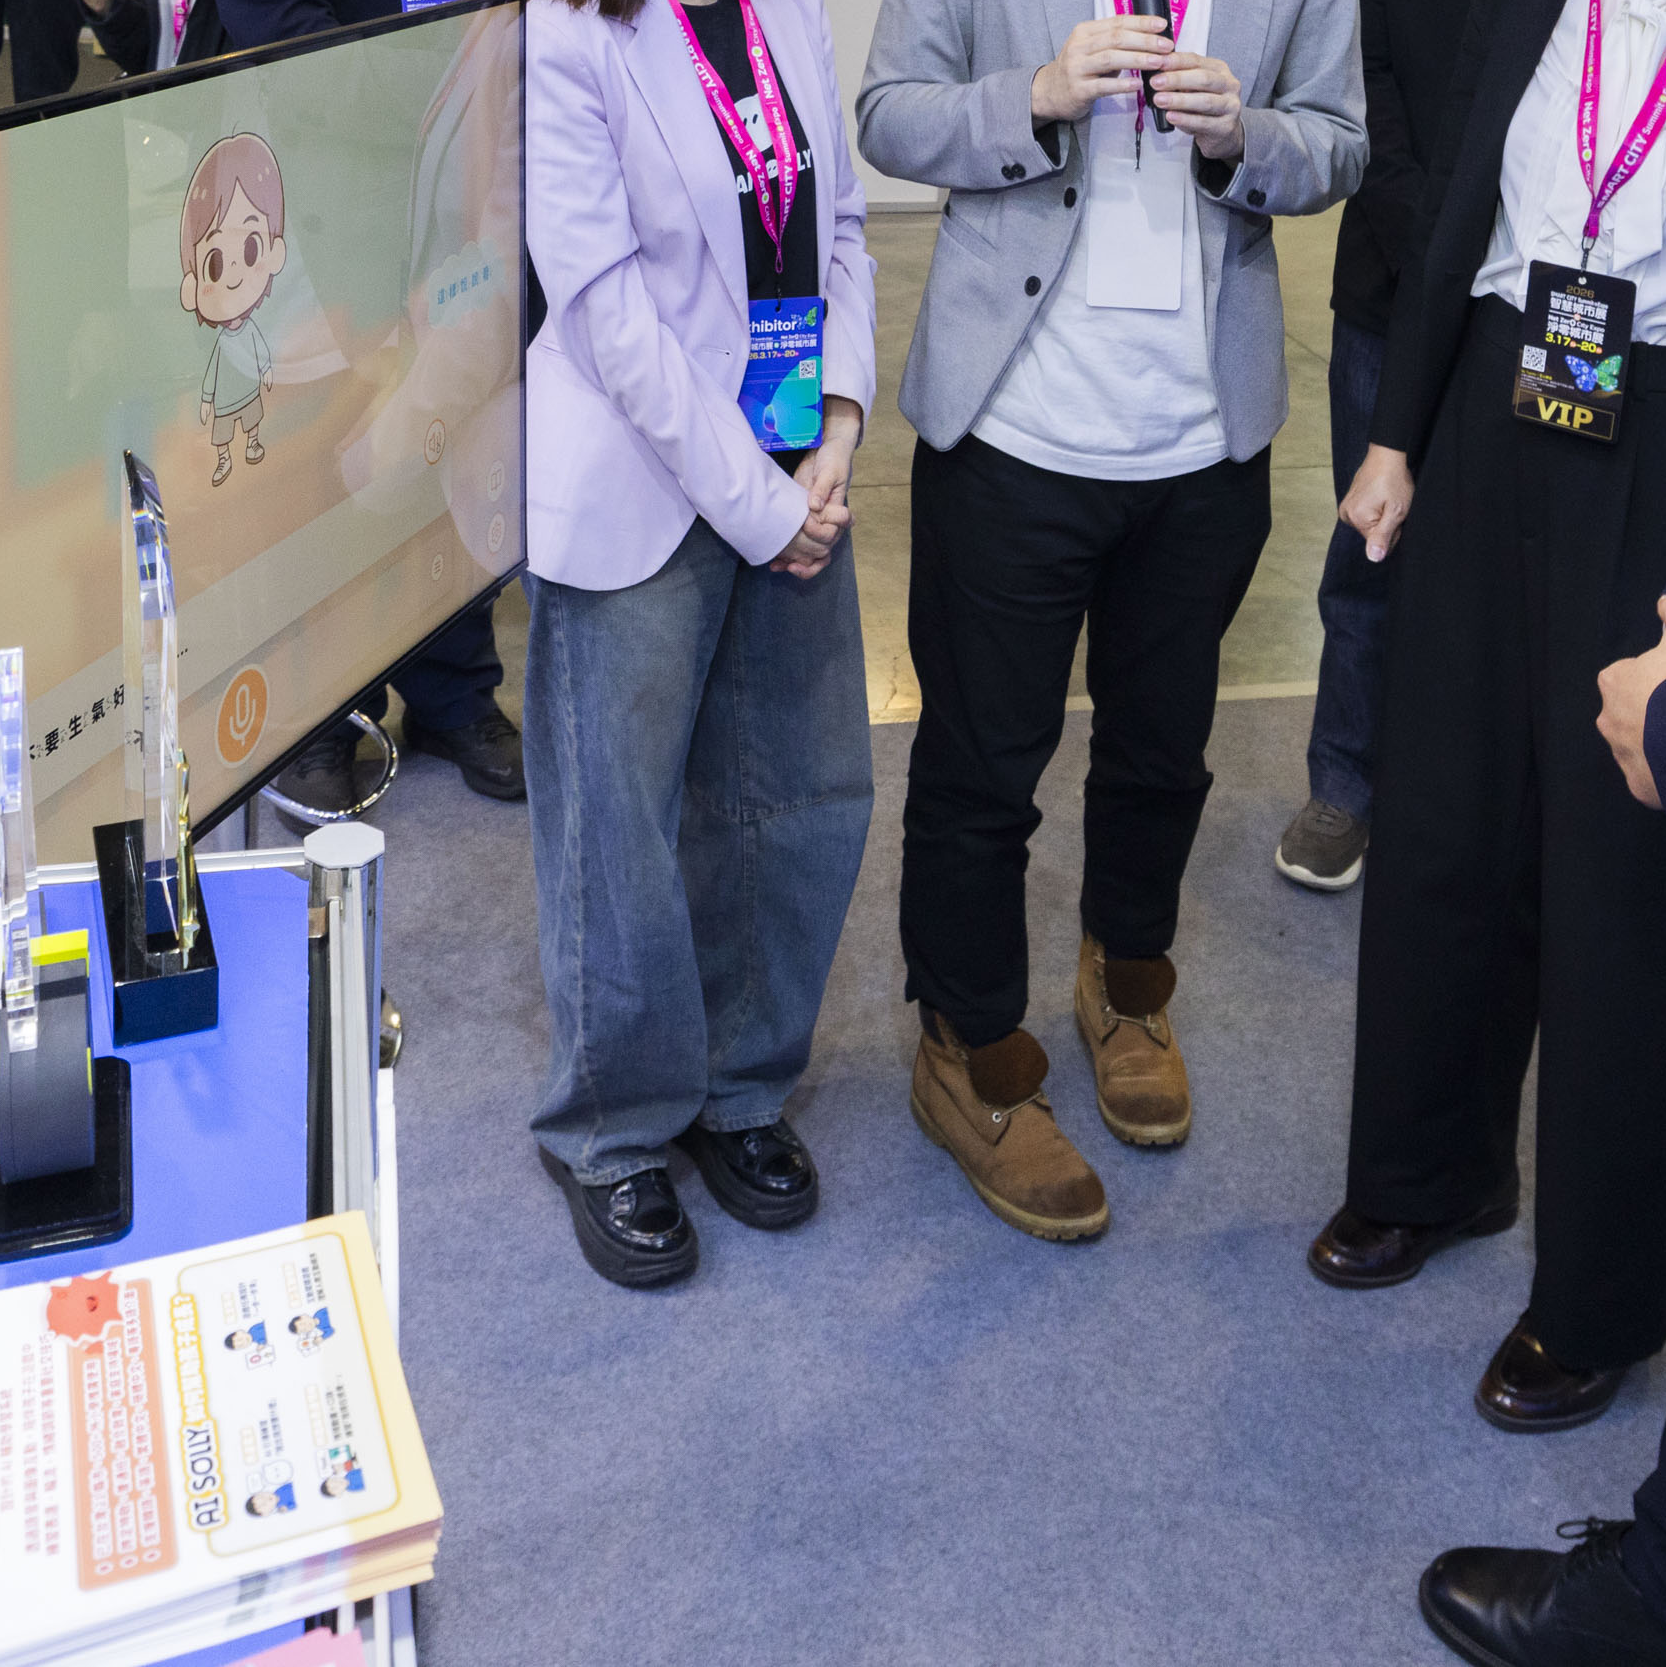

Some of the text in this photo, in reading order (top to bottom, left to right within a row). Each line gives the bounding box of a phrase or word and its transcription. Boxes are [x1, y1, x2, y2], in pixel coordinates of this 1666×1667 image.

[762, 77, 775, 101] Net
[694, 62, 717, 89] CITY
[710, 89, 731, 121] Summit
[730, 124, 745, 145] Expo
[744, 148, 762, 172] Net
[1583, 101, 1594, 126] Net
[1595, 164, 1630, 211] SMART
[1623, 133, 1648, 167] CITY
[1644, 101, 1665, 136] Summit
[1565, 284, 1596, 299] 2026
[1549, 297, 1608, 322] 智慧城市展
[1544, 331, 1572, 347] 3.17
[1545, 320, 1605, 346] 淨零城市展
[1536, 395, 1595, 429] VIP
[186, 1427, 216, 1492] SOLLY
[194, 1496, 221, 1527] AI
